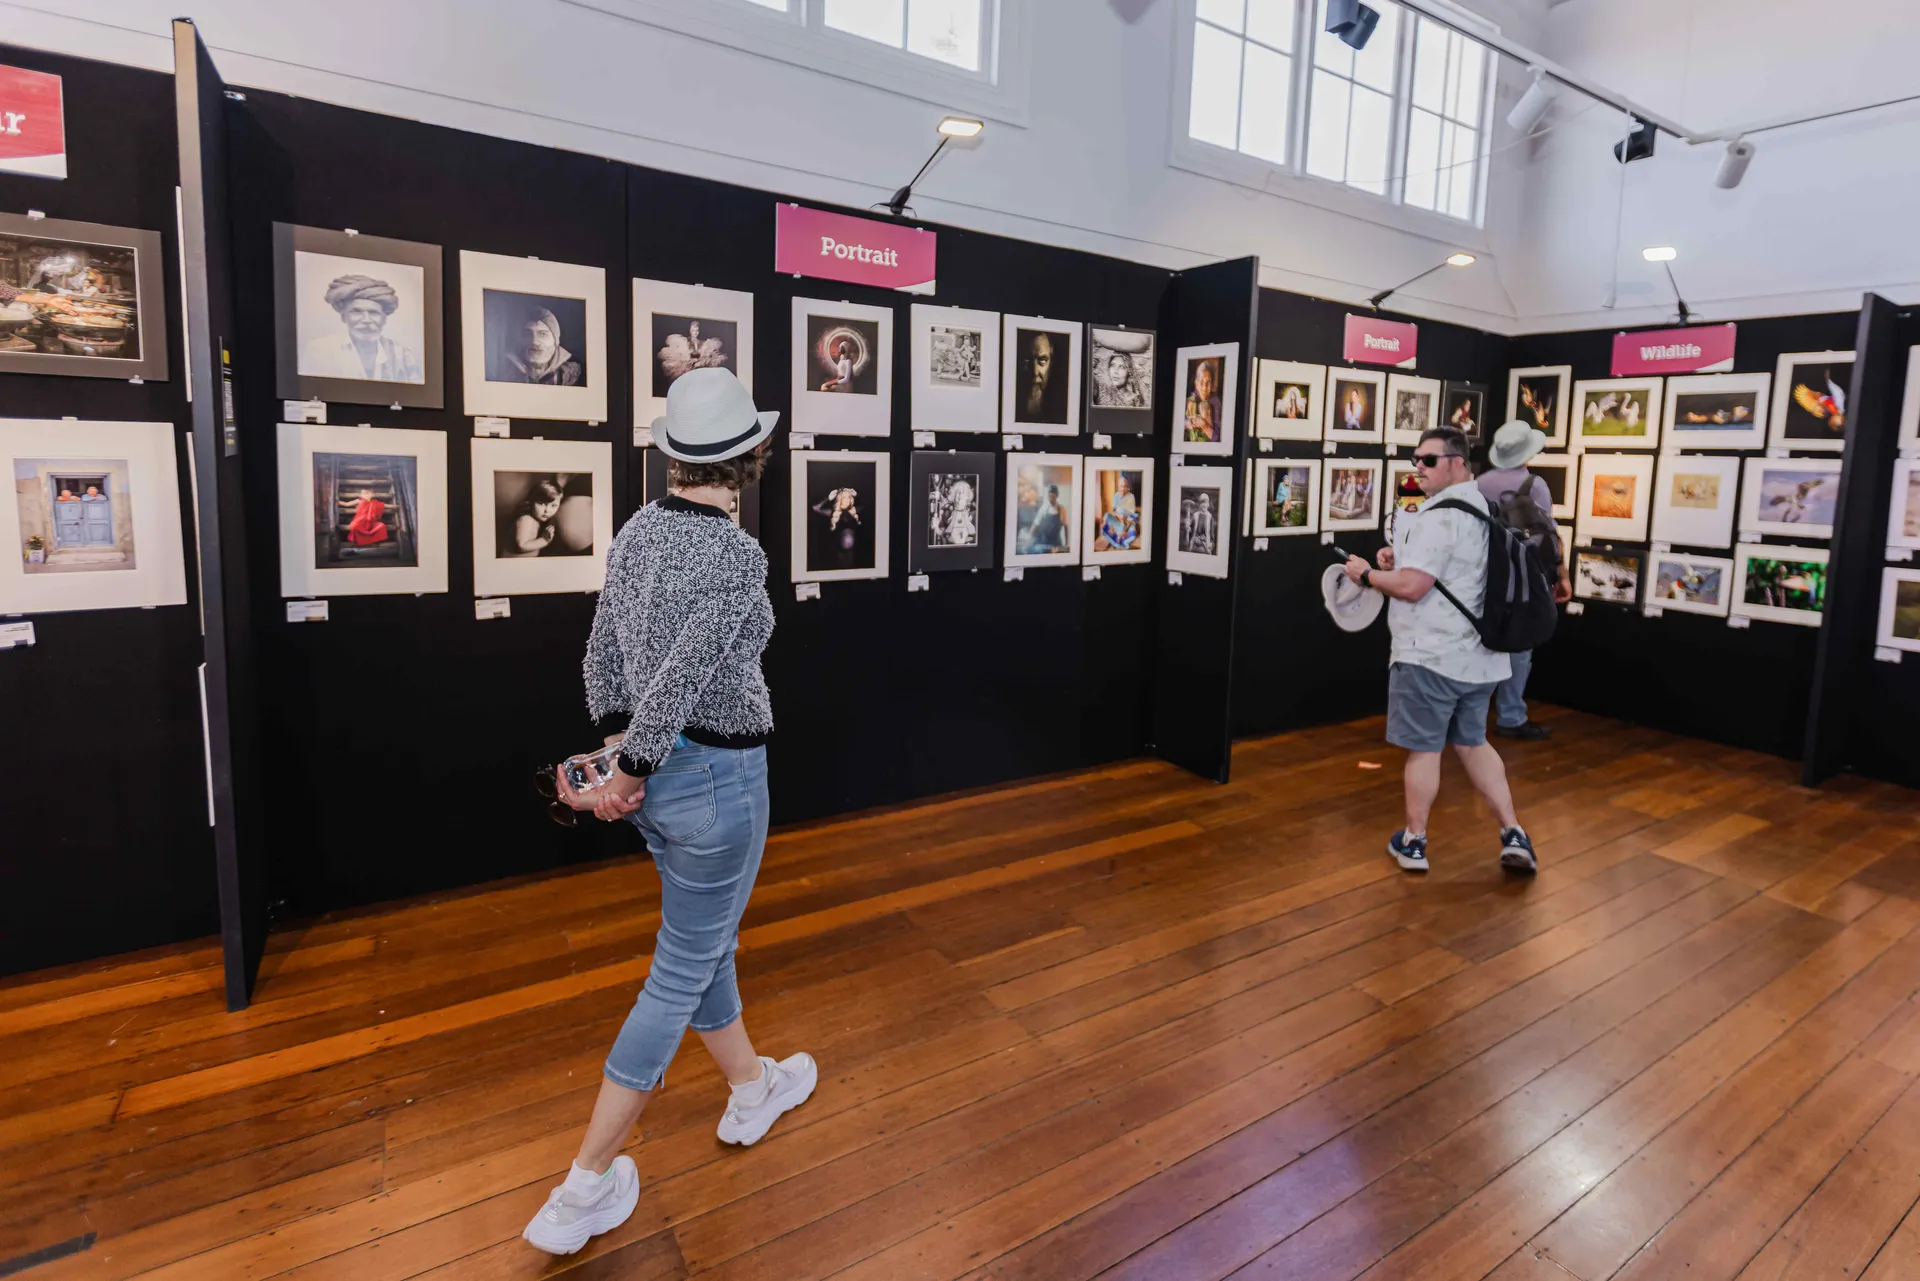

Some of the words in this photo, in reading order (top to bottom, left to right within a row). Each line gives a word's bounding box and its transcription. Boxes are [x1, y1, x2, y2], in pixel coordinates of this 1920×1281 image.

[0, 111, 26, 134] r
[820, 236, 898, 267] Portrait
[1364, 333, 1400, 352] Portrait
[1640, 343, 1701, 361] Wildlife
